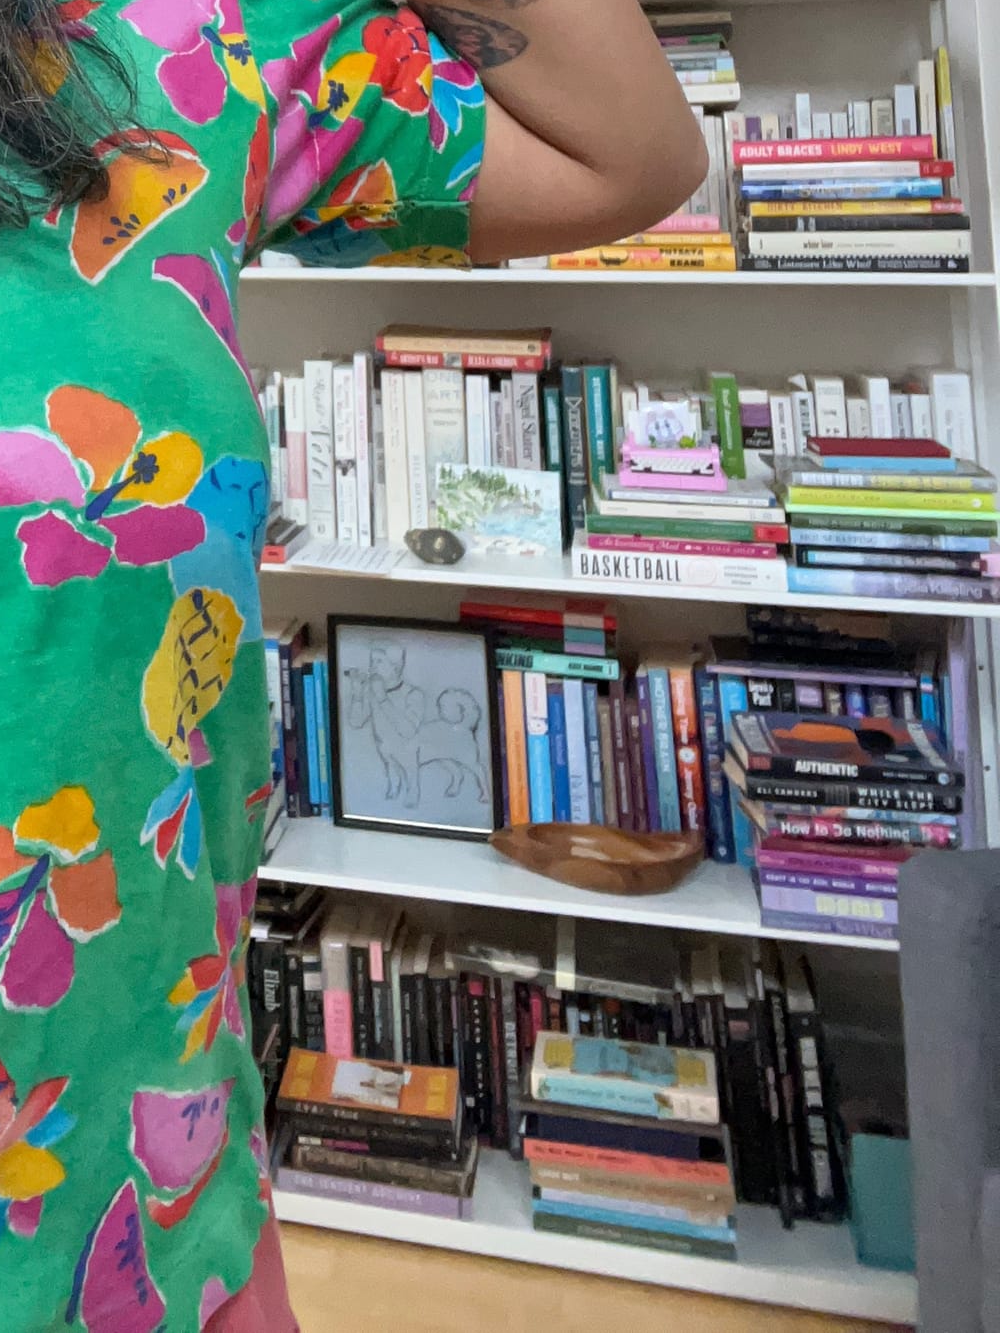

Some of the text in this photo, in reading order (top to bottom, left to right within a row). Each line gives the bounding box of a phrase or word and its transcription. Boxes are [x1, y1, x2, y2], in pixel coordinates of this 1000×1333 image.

[739, 142, 823, 159] ADULT BRACES
[830, 142, 902, 155] LINDY WEST
[425, 371, 460, 384] ONE
[428, 389, 461, 402] ART
[519, 383, 538, 462] Nigel Slater
[580, 552, 682, 583] BASKETBALL
[794, 760, 859, 778] AUTHENTIC
[857, 787, 934, 802] WHILE THE
[858, 798, 934, 811] CITY SLEPT
[781, 822, 911, 842] How to Do Nothing
[264, 969, 281, 1012] Elizab
